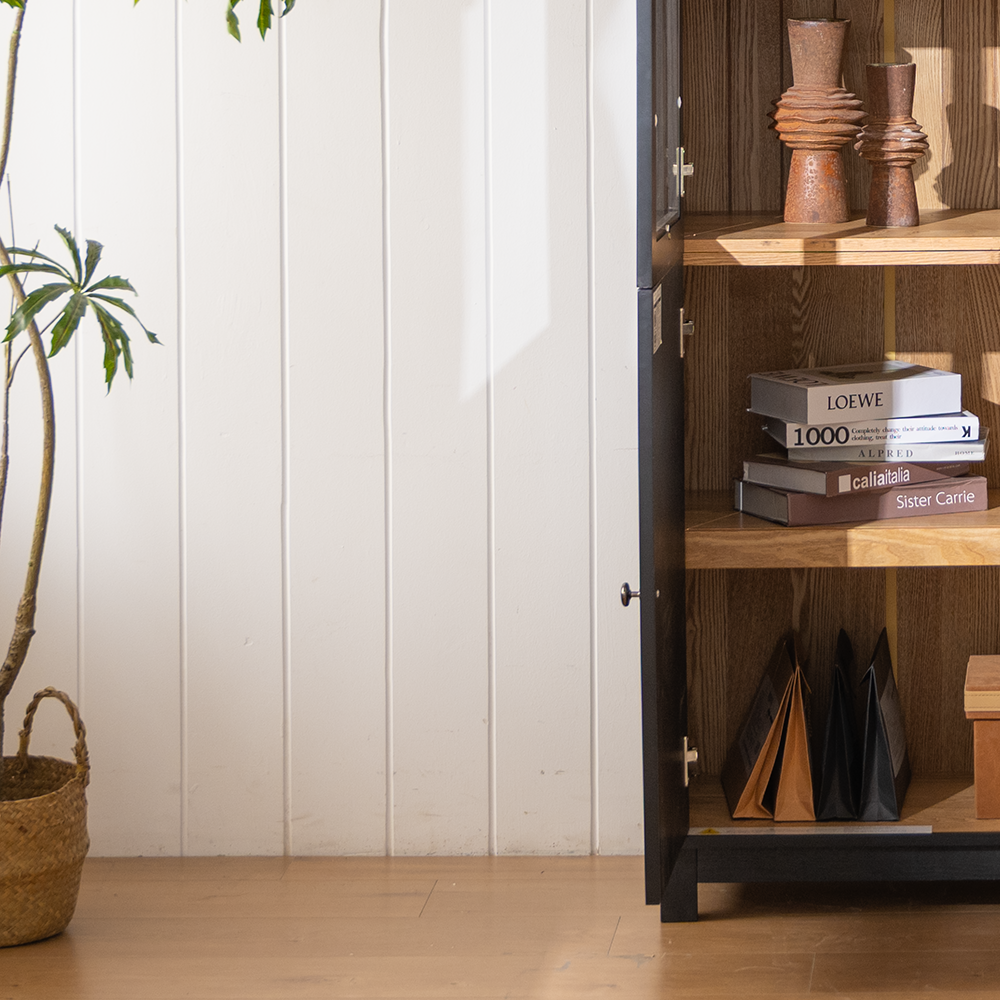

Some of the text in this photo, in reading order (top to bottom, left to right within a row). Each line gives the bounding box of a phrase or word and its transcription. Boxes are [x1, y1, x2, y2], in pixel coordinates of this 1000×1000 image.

[827, 392, 884, 411] LOEWE
[794, 426, 850, 446] 1000
[858, 449, 913, 458] ALPRED
[852, 467, 910, 490] caliaitalia
[896, 490, 975, 509] Sister Carrie
